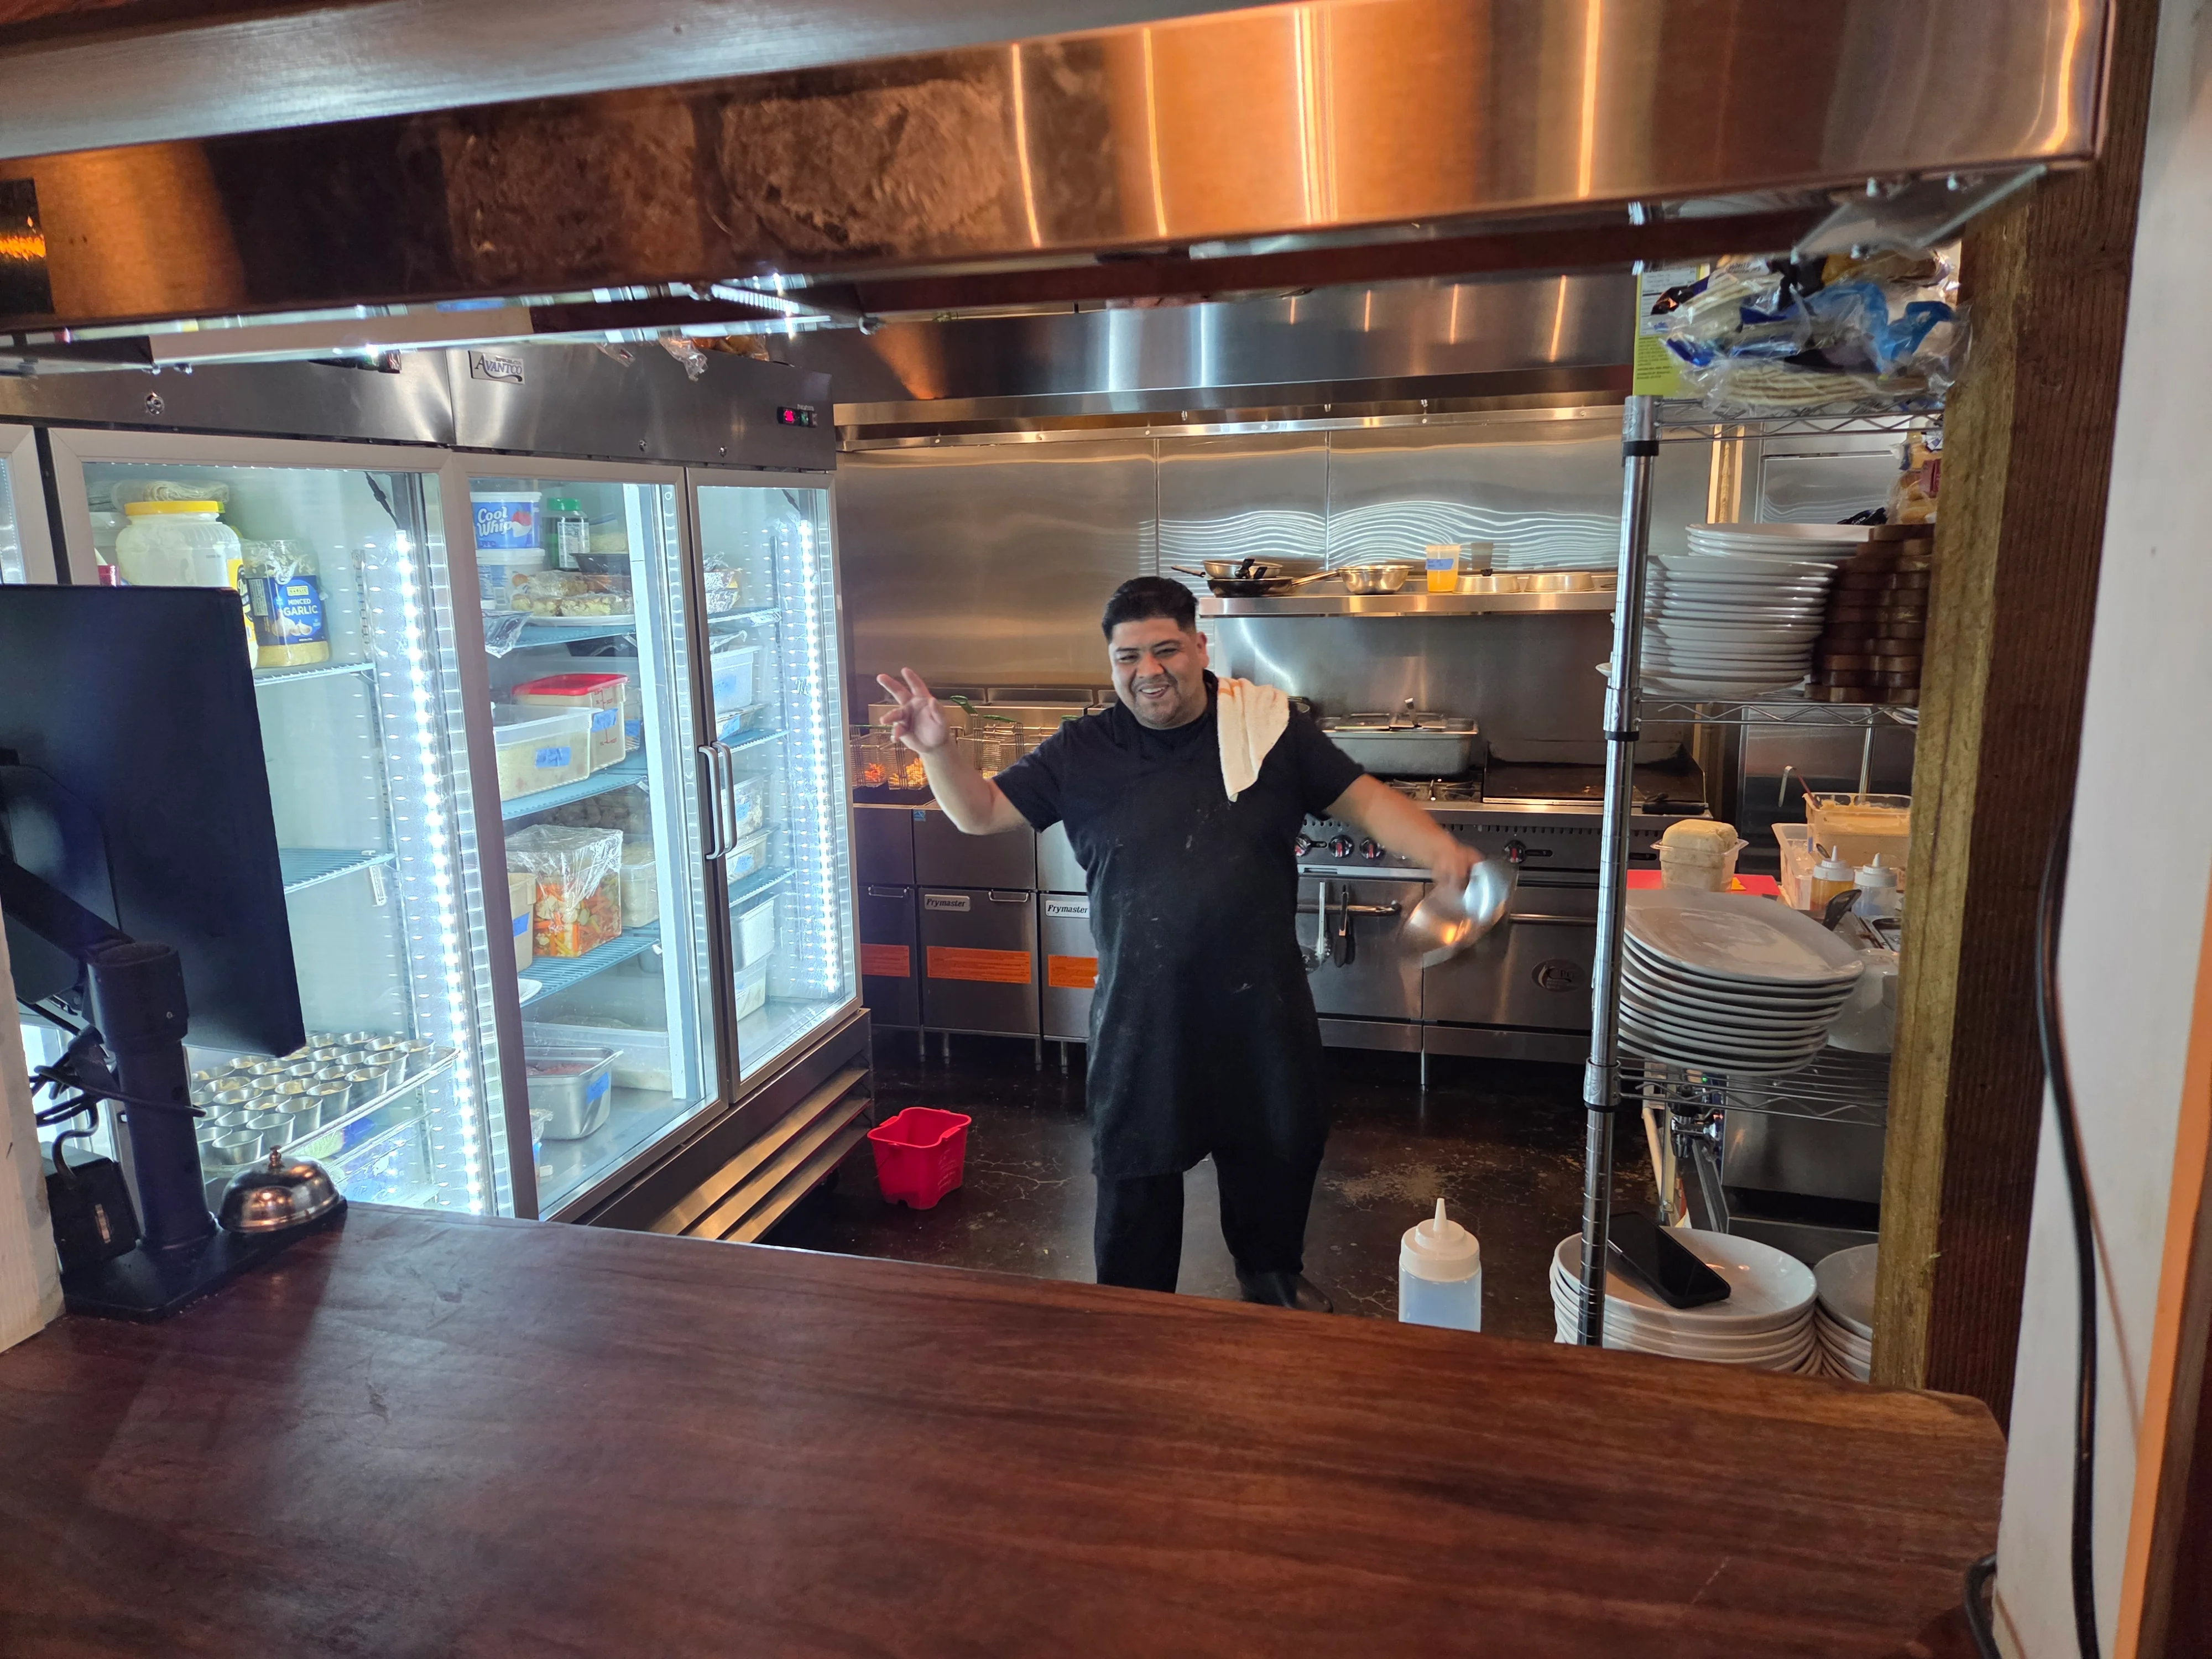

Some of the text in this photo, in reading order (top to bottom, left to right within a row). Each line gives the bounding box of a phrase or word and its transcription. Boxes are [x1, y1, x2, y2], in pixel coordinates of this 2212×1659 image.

[478, 506, 508, 523] Cool
[477, 519, 513, 537] Whip
[283, 605, 319, 616] GARLIC
[926, 898, 966, 908] Frymaster
[1047, 904, 1088, 914] Frymaster
